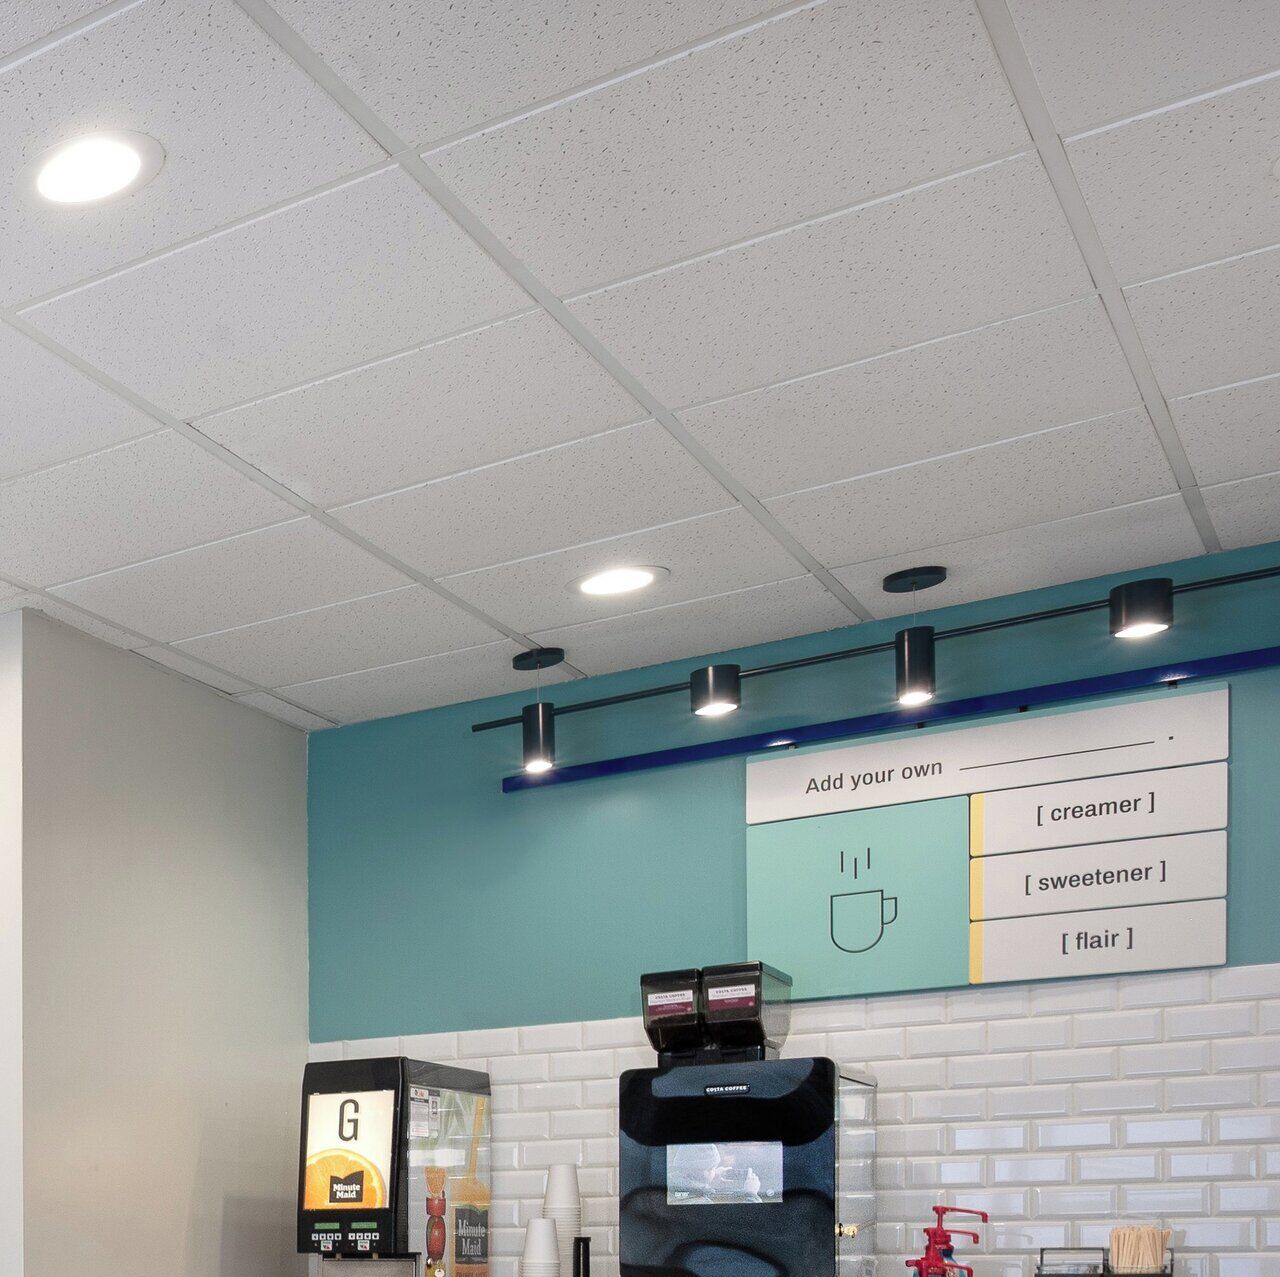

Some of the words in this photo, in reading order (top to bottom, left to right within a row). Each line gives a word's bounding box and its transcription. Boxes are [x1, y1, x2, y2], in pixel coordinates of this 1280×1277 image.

[805, 772, 844, 794] Add
[850, 767, 895, 792] your
[901, 761, 943, 780] own
[1050, 797, 1142, 823] creamer
[1038, 866, 1153, 891] sweetener
[1075, 931, 1120, 951] flair
[338, 1098, 359, 1142] G
[332, 1183, 361, 1192] Minute
[336, 1190, 357, 1199] Maid
[458, 1219, 486, 1238] Minute
[462, 1238, 482, 1256] Maid
